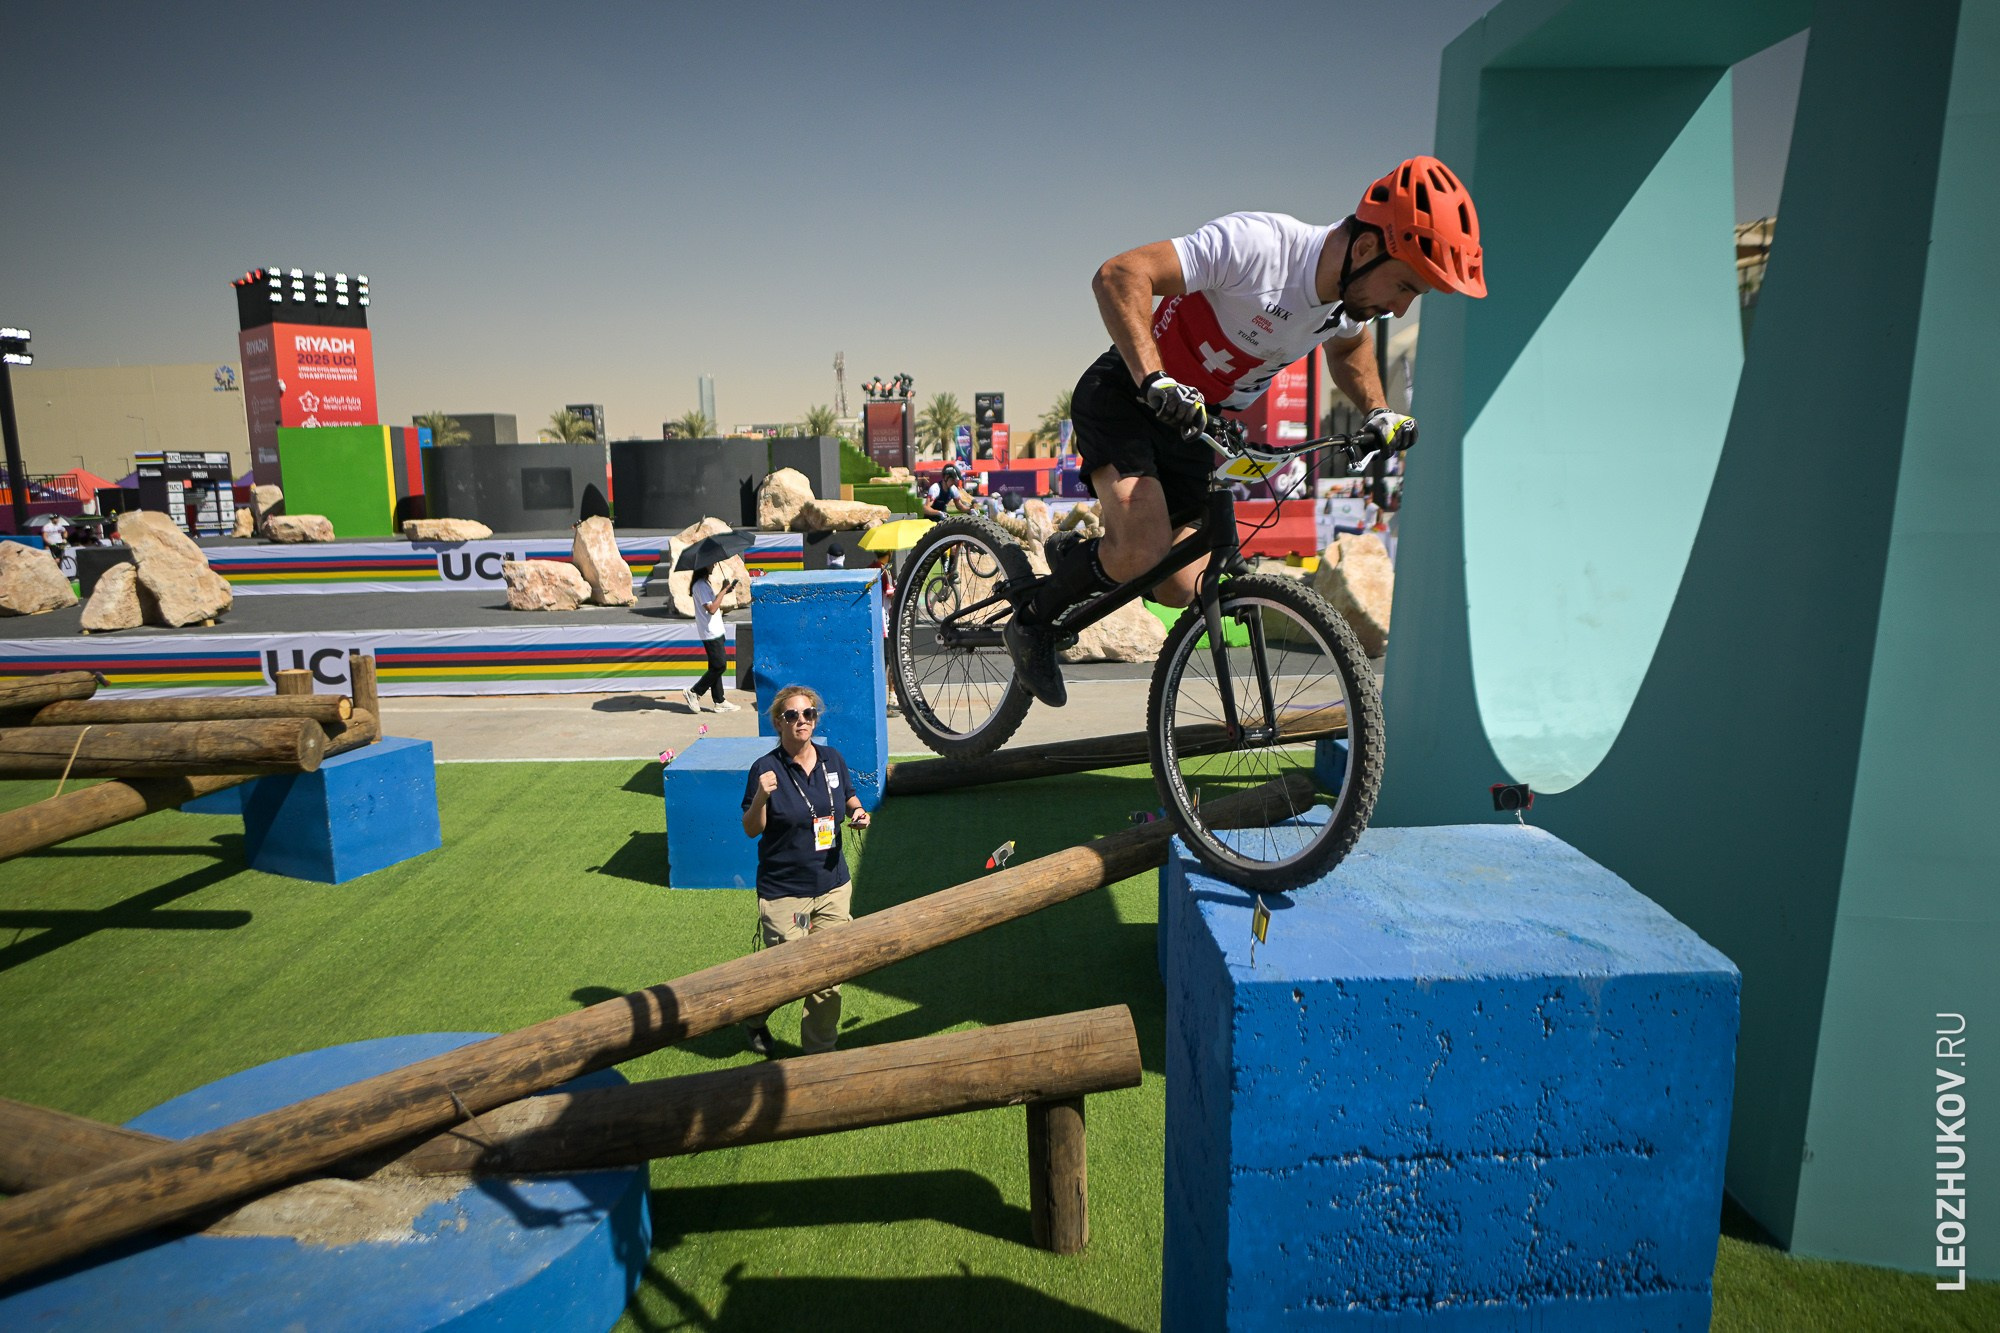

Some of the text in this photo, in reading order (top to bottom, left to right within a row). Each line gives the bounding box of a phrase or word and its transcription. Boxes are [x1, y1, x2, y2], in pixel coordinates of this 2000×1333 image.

[1252, 318, 1274, 334] CYCLING
[1256, 315, 1272, 326] SWISS
[295, 335, 355, 354] RIYADH
[1237, 330, 1259, 346] TUDOR
[297, 353, 357, 366] 2025 UCI
[298, 372, 358, 381] CHAMPIONSHIPS
[441, 551, 515, 581] UC
